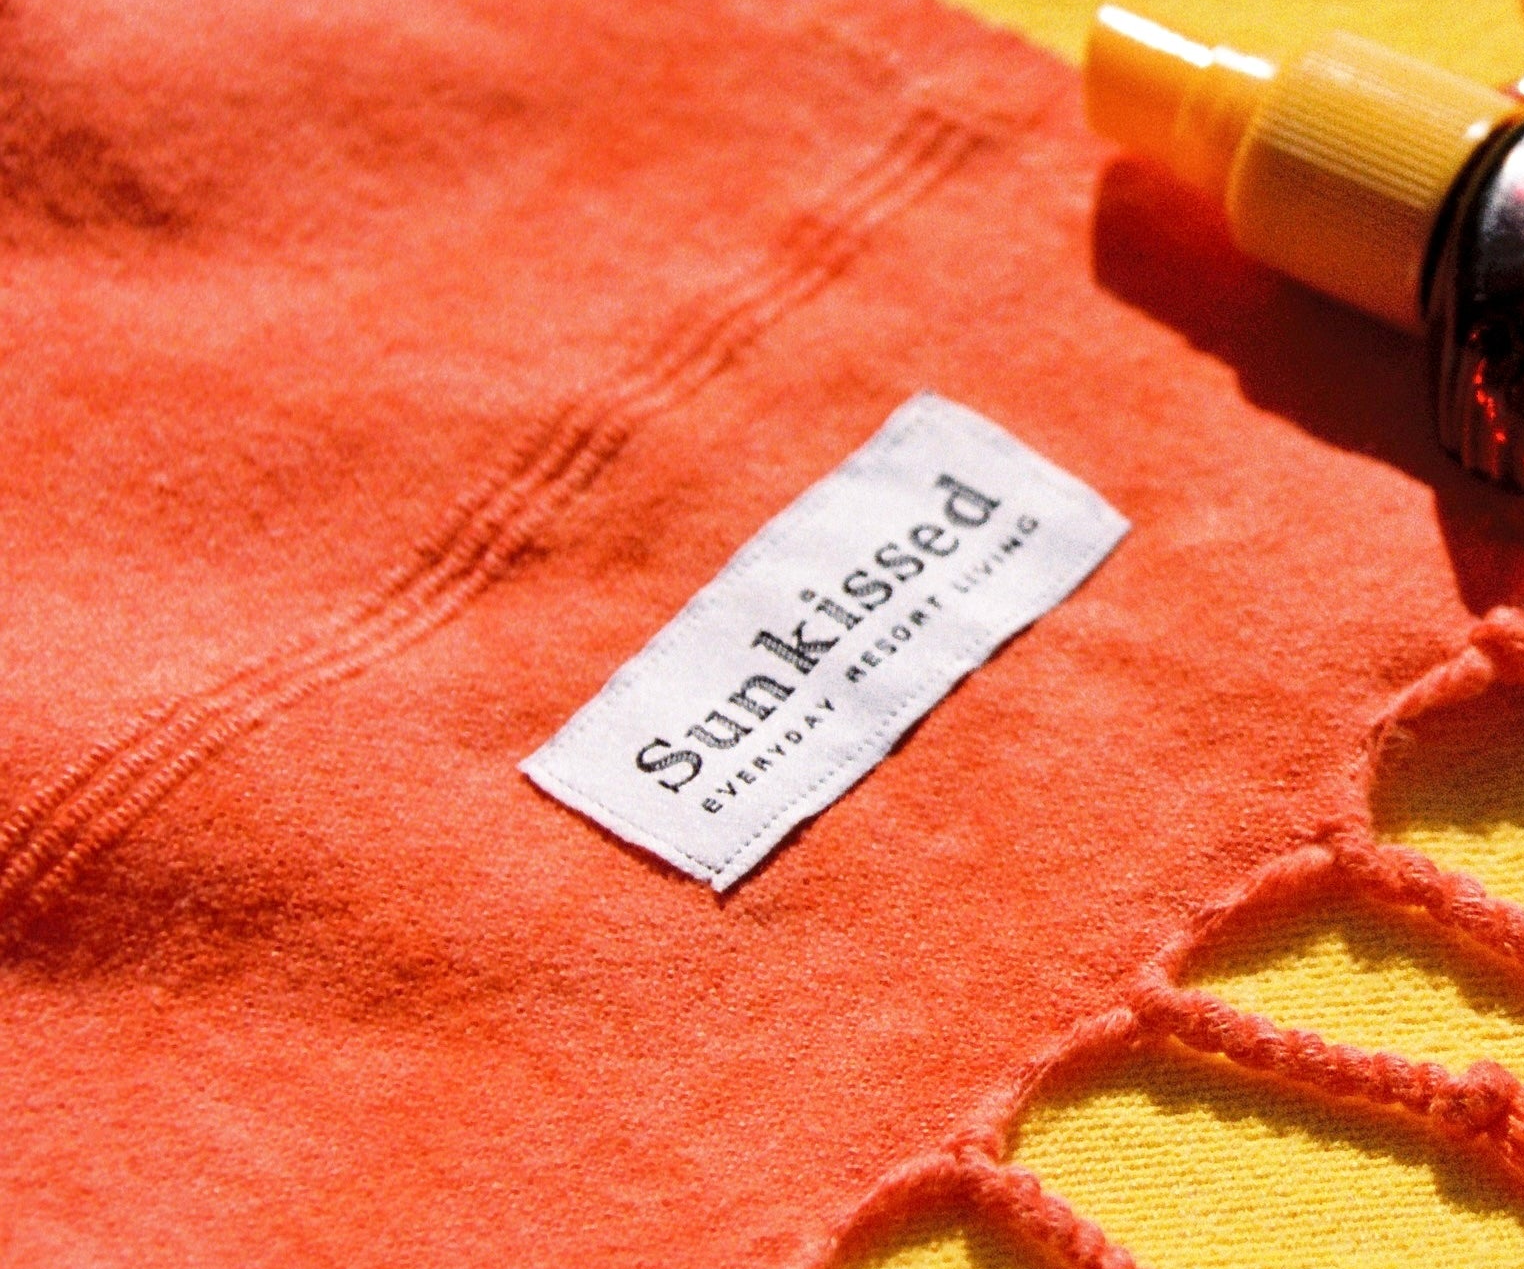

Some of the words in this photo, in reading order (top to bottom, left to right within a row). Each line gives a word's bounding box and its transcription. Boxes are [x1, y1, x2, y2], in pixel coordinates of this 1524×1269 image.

[634, 473, 1002, 793] Sunkissed
[702, 697, 837, 814] EVERYDAY
[846, 597, 945, 684] RESORT
[958, 515, 1040, 594] LIVING
